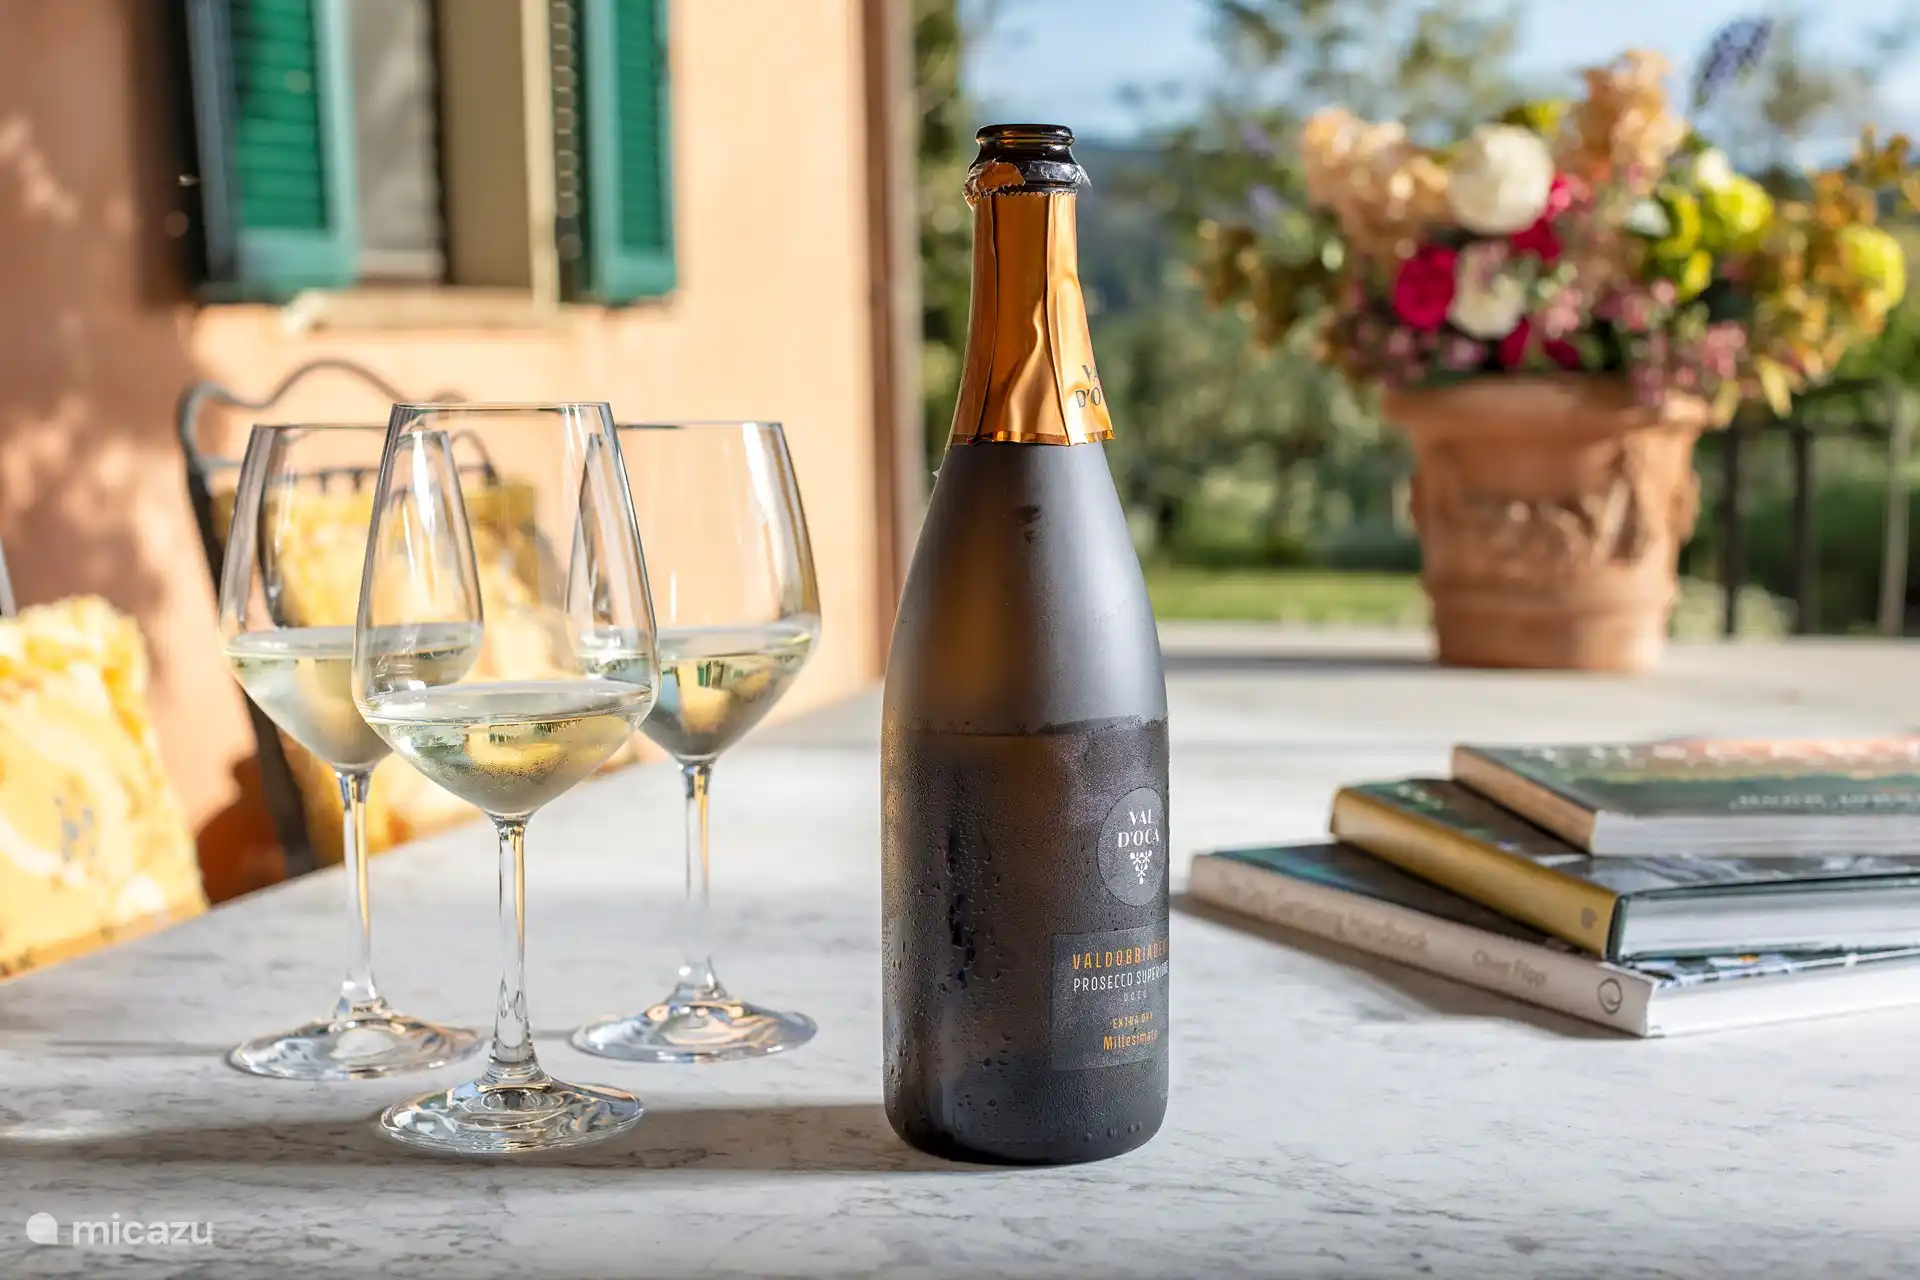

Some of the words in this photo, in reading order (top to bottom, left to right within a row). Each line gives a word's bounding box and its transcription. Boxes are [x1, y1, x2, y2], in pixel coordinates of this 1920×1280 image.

[1128, 808, 1154, 826] VAL
[1117, 827, 1160, 848] D'OCA
[1073, 972, 1133, 993] PROSECCO
